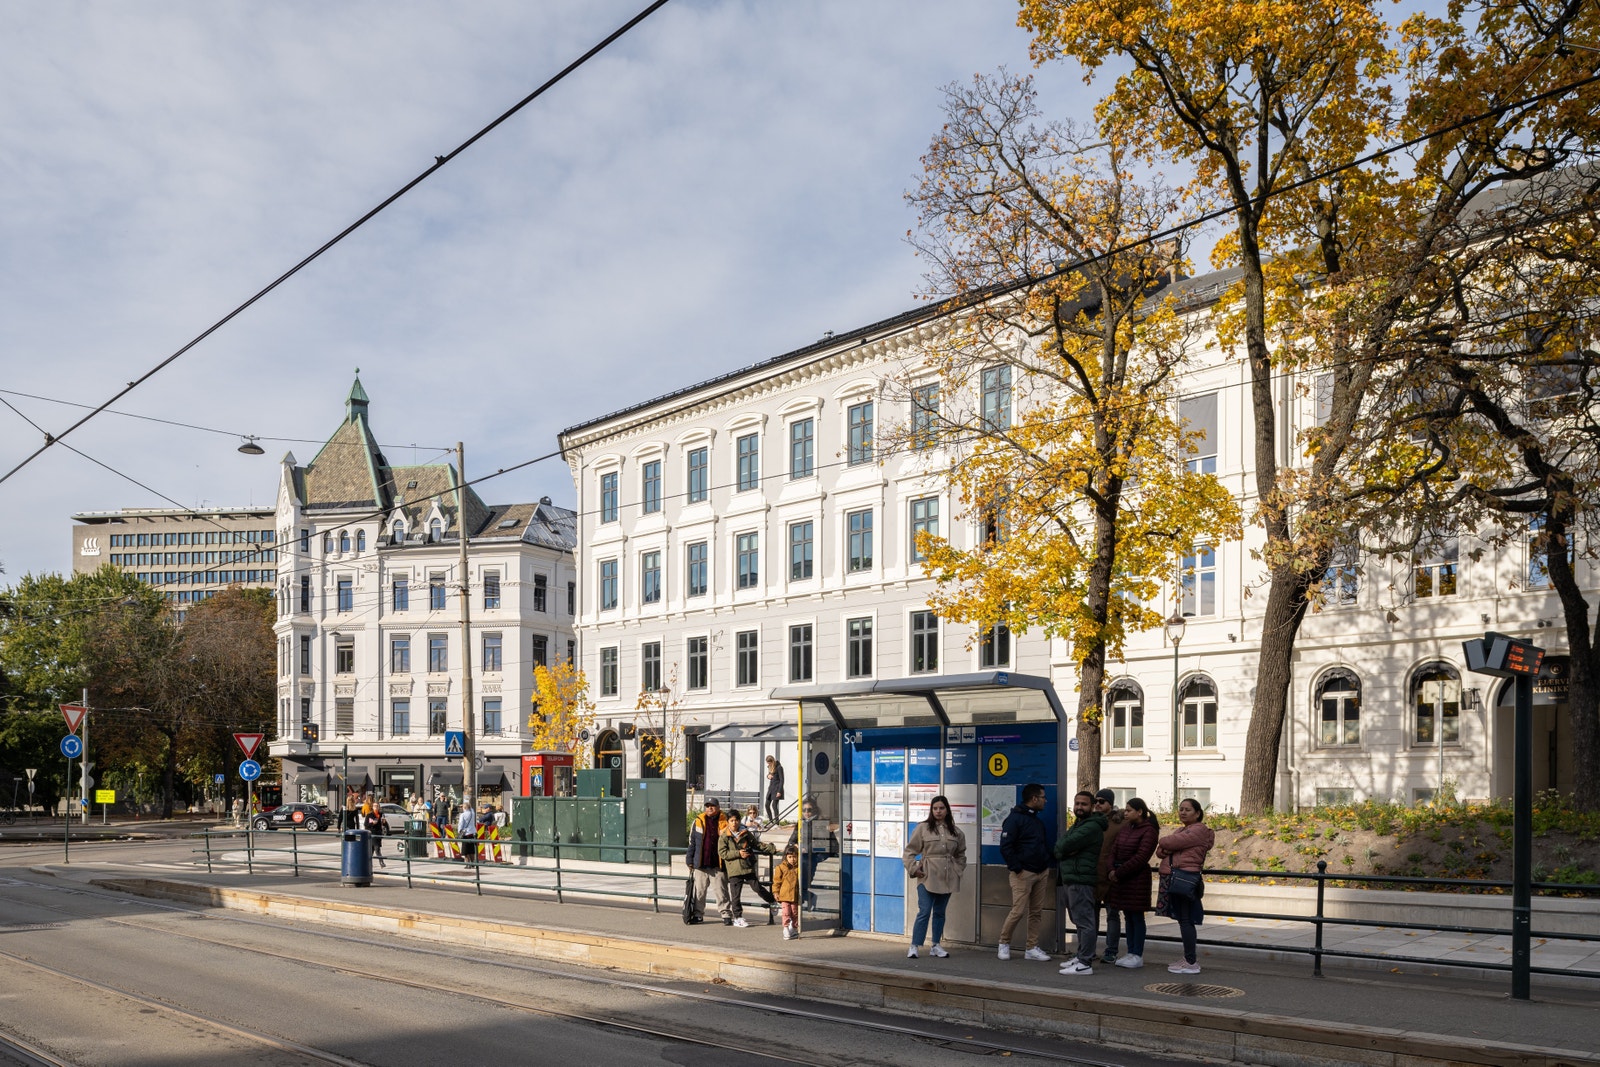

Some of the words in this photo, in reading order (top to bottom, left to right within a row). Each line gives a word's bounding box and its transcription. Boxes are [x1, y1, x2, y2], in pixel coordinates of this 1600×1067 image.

[1532, 685, 1569, 694] KLINIKK
[844, 731, 863, 744] Solli
[994, 758, 1003, 771] B
